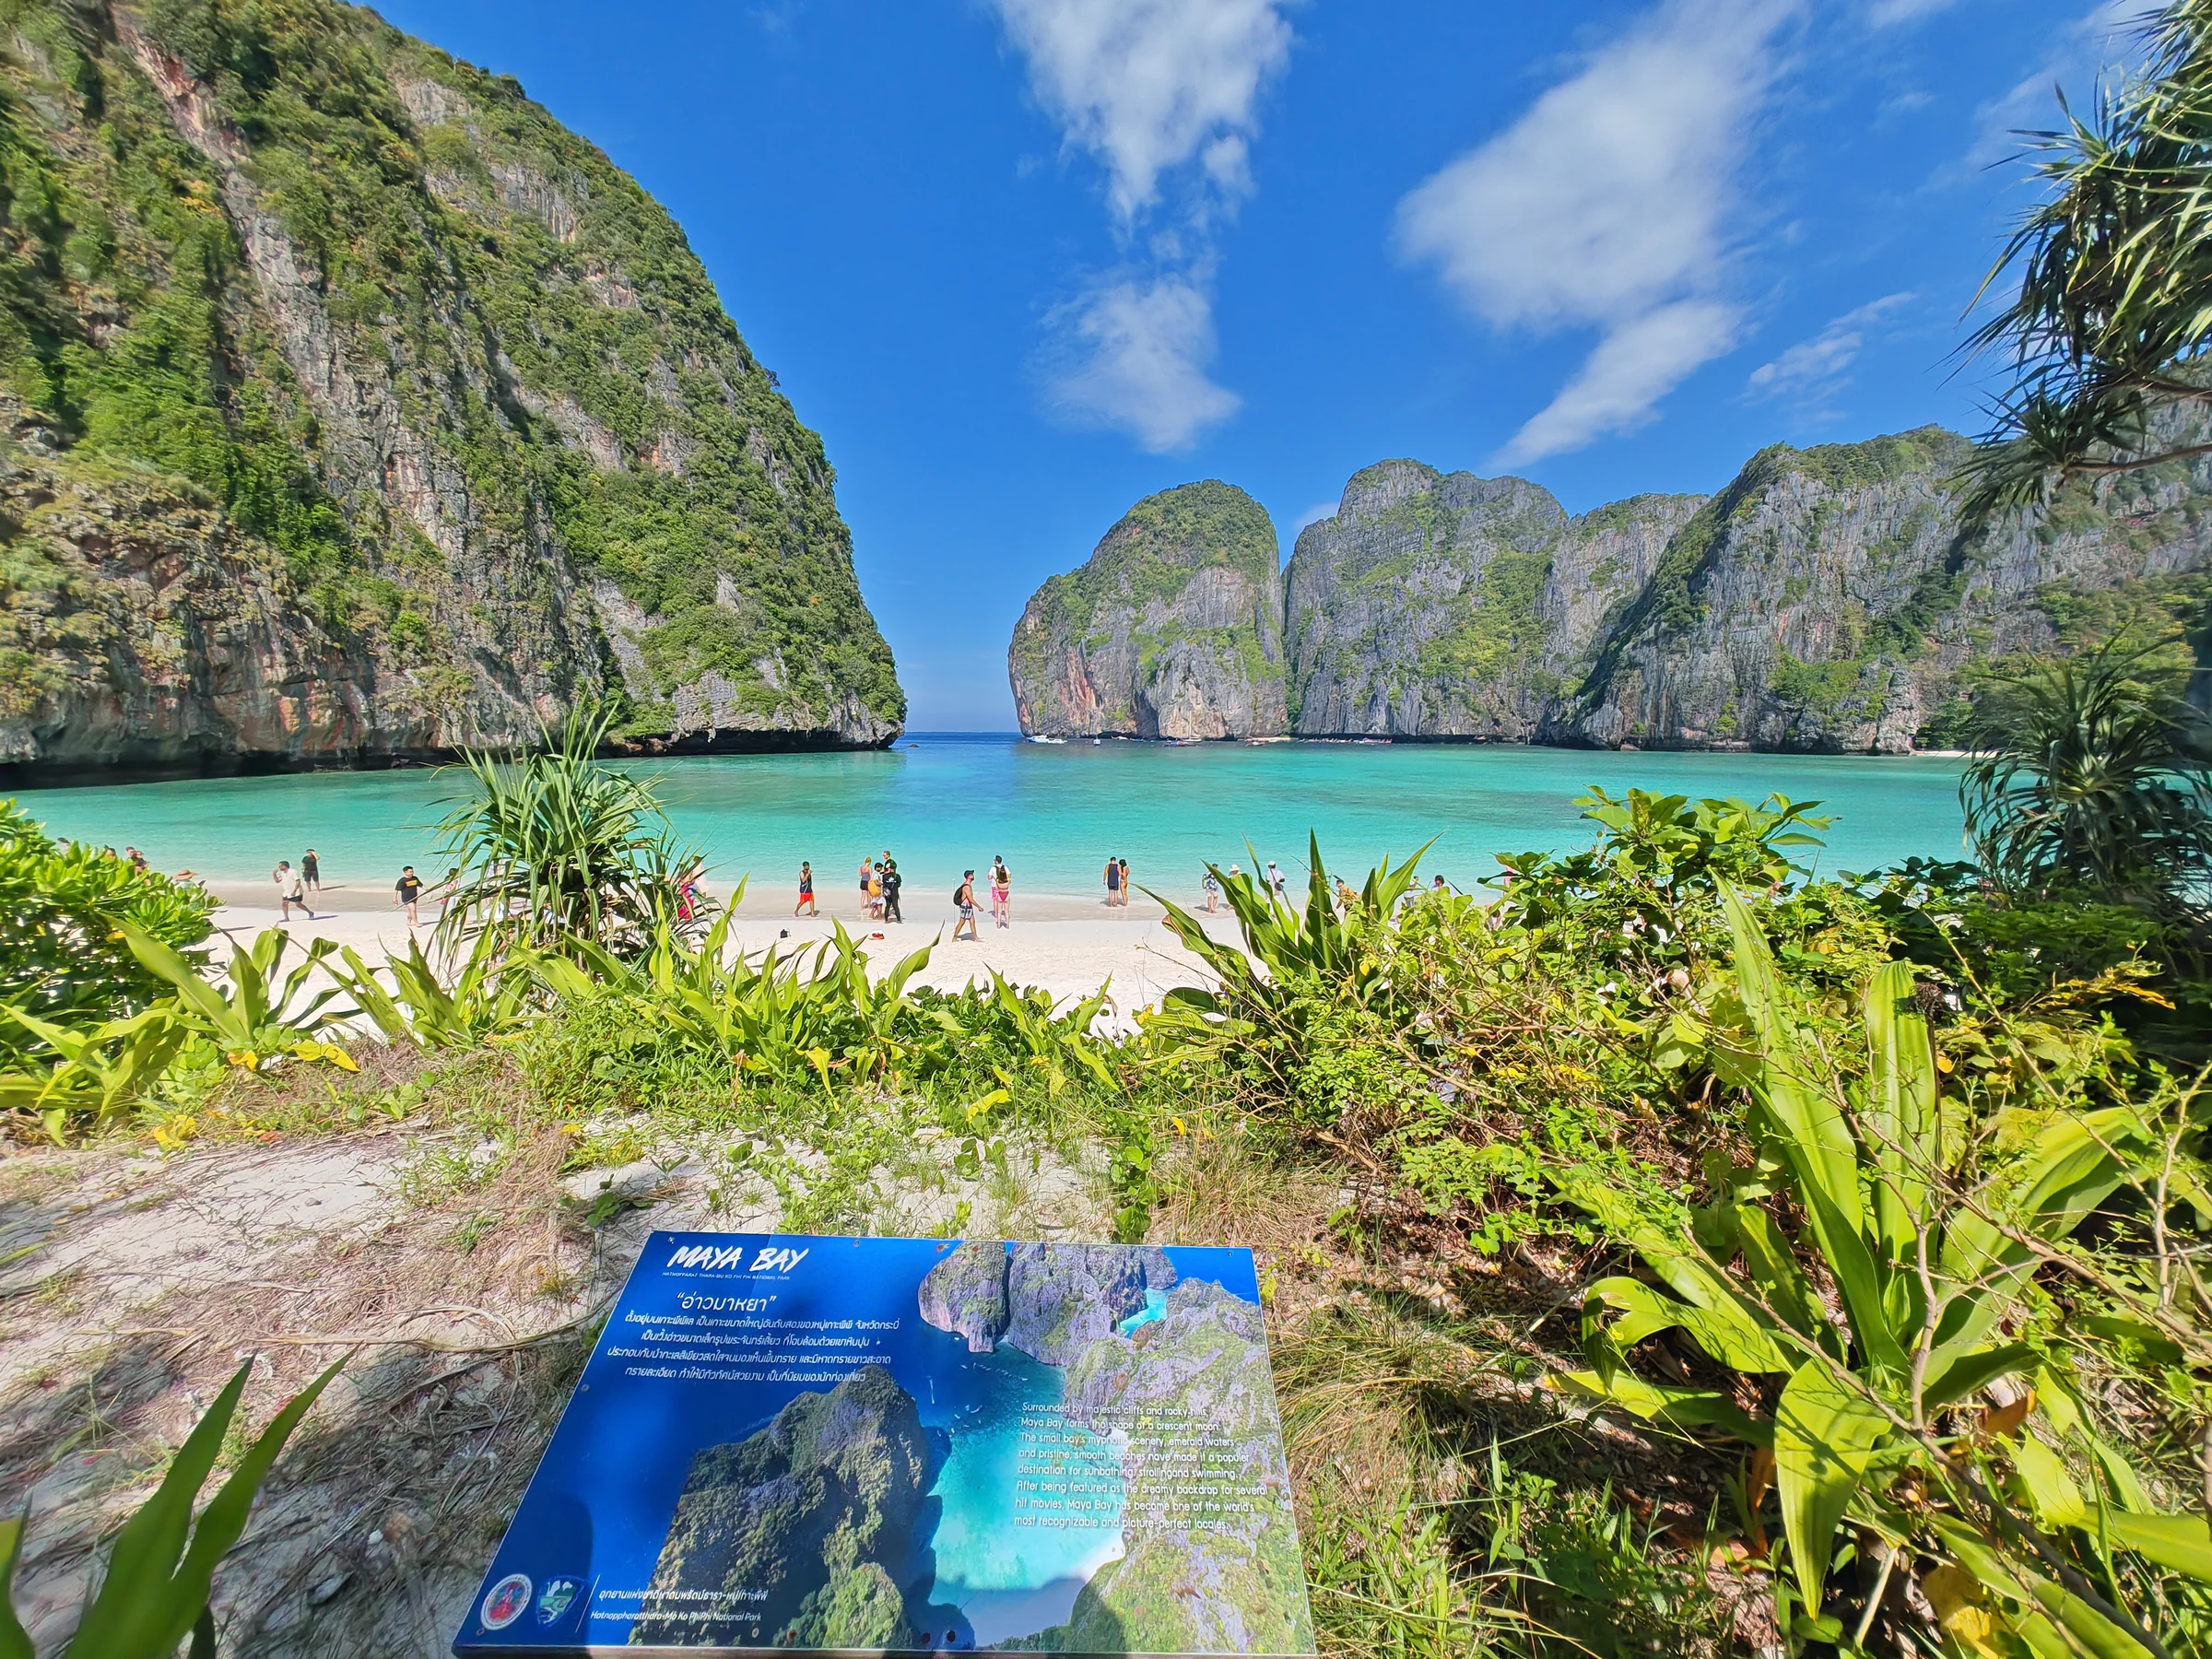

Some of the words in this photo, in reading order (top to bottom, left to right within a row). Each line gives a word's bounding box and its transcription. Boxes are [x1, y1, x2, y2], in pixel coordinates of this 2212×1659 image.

[666, 1245, 743, 1271] MAYA
[749, 1247, 809, 1273] BAY
[677, 1290, 777, 1312] “อ่าวมาหยา”
[1022, 1402, 1069, 1412] Surrounded
[1072, 1405, 1083, 1415] by
[1086, 1405, 1121, 1416] majestic
[1124, 1405, 1143, 1415] cliffs
[1146, 1406, 1162, 1415] and
[1165, 1407, 1188, 1418] rocky
[1021, 1418, 1044, 1429] Maya
[1047, 1418, 1063, 1429] Bay
[1066, 1419, 1089, 1429] forms
[1092, 1419, 1106, 1429] the
[1108, 1420, 1134, 1431] shape
[1136, 1420, 1145, 1430] of
[1157, 1422, 1193, 1431] crescent
[1020, 1432, 1036, 1442] The
[1039, 1433, 1060, 1443] small
[1169, 1437, 1203, 1446] emerald
[1018, 1449, 1036, 1458] and
[1039, 1449, 1072, 1460] pristine,
[1075, 1450, 1106, 1459] smooth
[1109, 1451, 1146, 1461] beaches
[1174, 1453, 1197, 1462] made
[1200, 1453, 1206, 1462] it
[1018, 1465, 1066, 1475] destination
[1069, 1465, 1082, 1475] for
[1017, 1480, 1038, 1491] After
[1041, 1482, 1067, 1494] being
[1070, 1481, 1107, 1492] featured
[1124, 1483, 1138, 1493] the
[1141, 1485, 1174, 1496] dreamy
[1177, 1485, 1218, 1496] backdrop
[1221, 1485, 1233, 1494] for
[1236, 1485, 1268, 1495] several
[1015, 1498, 1028, 1507] hit
[1031, 1498, 1065, 1510] movies,
[1067, 1500, 1092, 1511] Maya
[1094, 1500, 1112, 1512] Bay
[1115, 1500, 1131, 1510] has
[1134, 1500, 1170, 1511] become
[1193, 1501, 1202, 1511] of
[1205, 1501, 1220, 1511] the
[1014, 1516, 1036, 1526] most
[1039, 1517, 1098, 1529] recognizable
[1101, 1518, 1119, 1527] and
[1122, 1518, 1191, 1530] picture-perfect
[713, 1611, 744, 1622] National
[745, 1612, 761, 1622] Park
